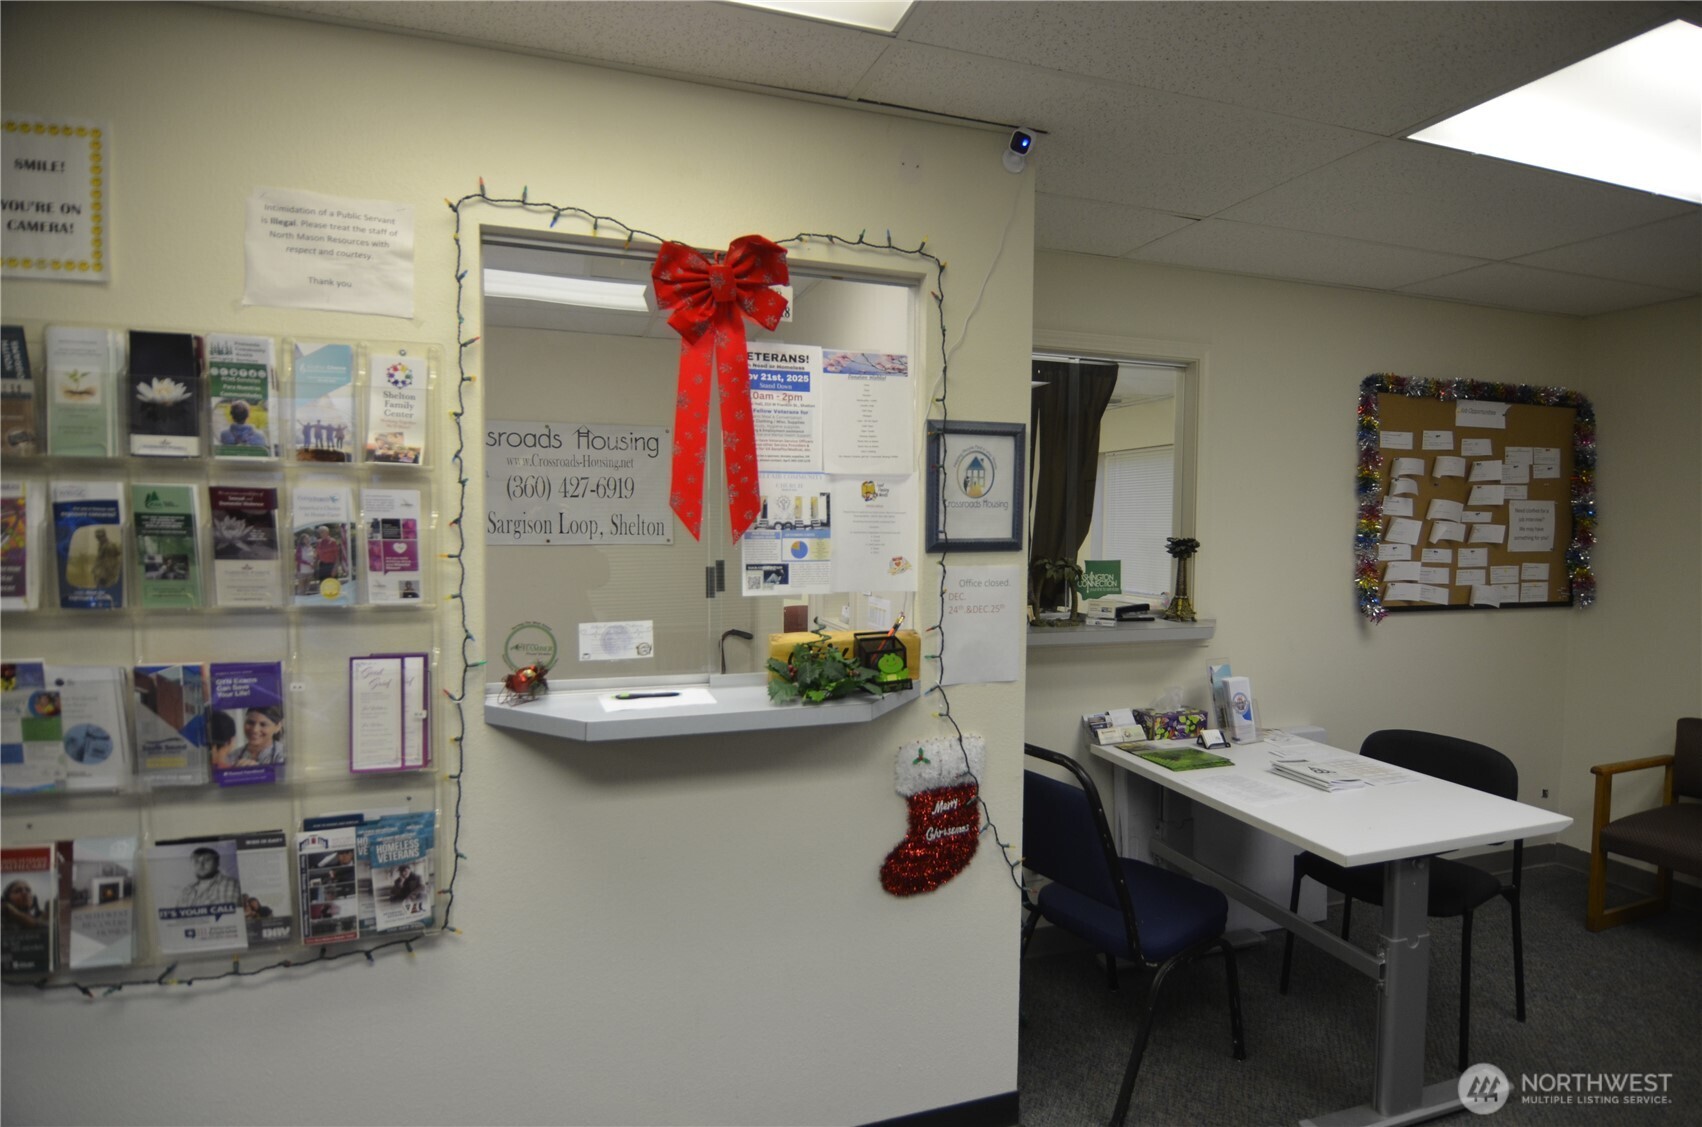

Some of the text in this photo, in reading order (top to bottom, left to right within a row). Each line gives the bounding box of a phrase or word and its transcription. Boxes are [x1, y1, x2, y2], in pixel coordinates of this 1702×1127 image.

[14, 159, 65, 173] SMILE!
[0, 199, 81, 215] YOU'RE ON
[264, 203, 316, 215] Intimidation
[318, 208, 328, 216] of
[336, 210, 362, 221] Public
[364, 214, 396, 225] Servant
[7, 219, 74, 234] CAMERA!
[300, 220, 328, 230] Please
[330, 223, 350, 232] treat
[352, 225, 366, 234] the
[368, 228, 388, 236] staff
[389, 230, 398, 238] of
[269, 230, 390, 249] North Mason Resources with
[286, 244, 317, 255] respect
[318, 248, 334, 257] and
[308, 276, 352, 288] Thank you
[747, 352, 810, 364] ETERANS!
[761, 373, 784, 382] 21st,
[786, 374, 810, 382] 2025
[383, 390, 416, 401] Shelton
[782, 392, 804, 402] 2pm
[384, 400, 414, 411] Family
[384, 409, 414, 419] Center
[486, 424, 660, 458] sroads Housing
[506, 453, 634, 470] www.Crossroads-Housing.net
[506, 475, 635, 501] (360) 427-6919
[983, 500, 1008, 510] Housing
[487, 511, 665, 540] Sargison Loop, Shelton
[959, 578, 982, 588] Office
[931, 798, 958, 815] Merry
[376, 838, 420, 854] HOMELESS
[377, 848, 420, 864] VETERANS
[160, 904, 234, 918] IT'S YOUR CALL
